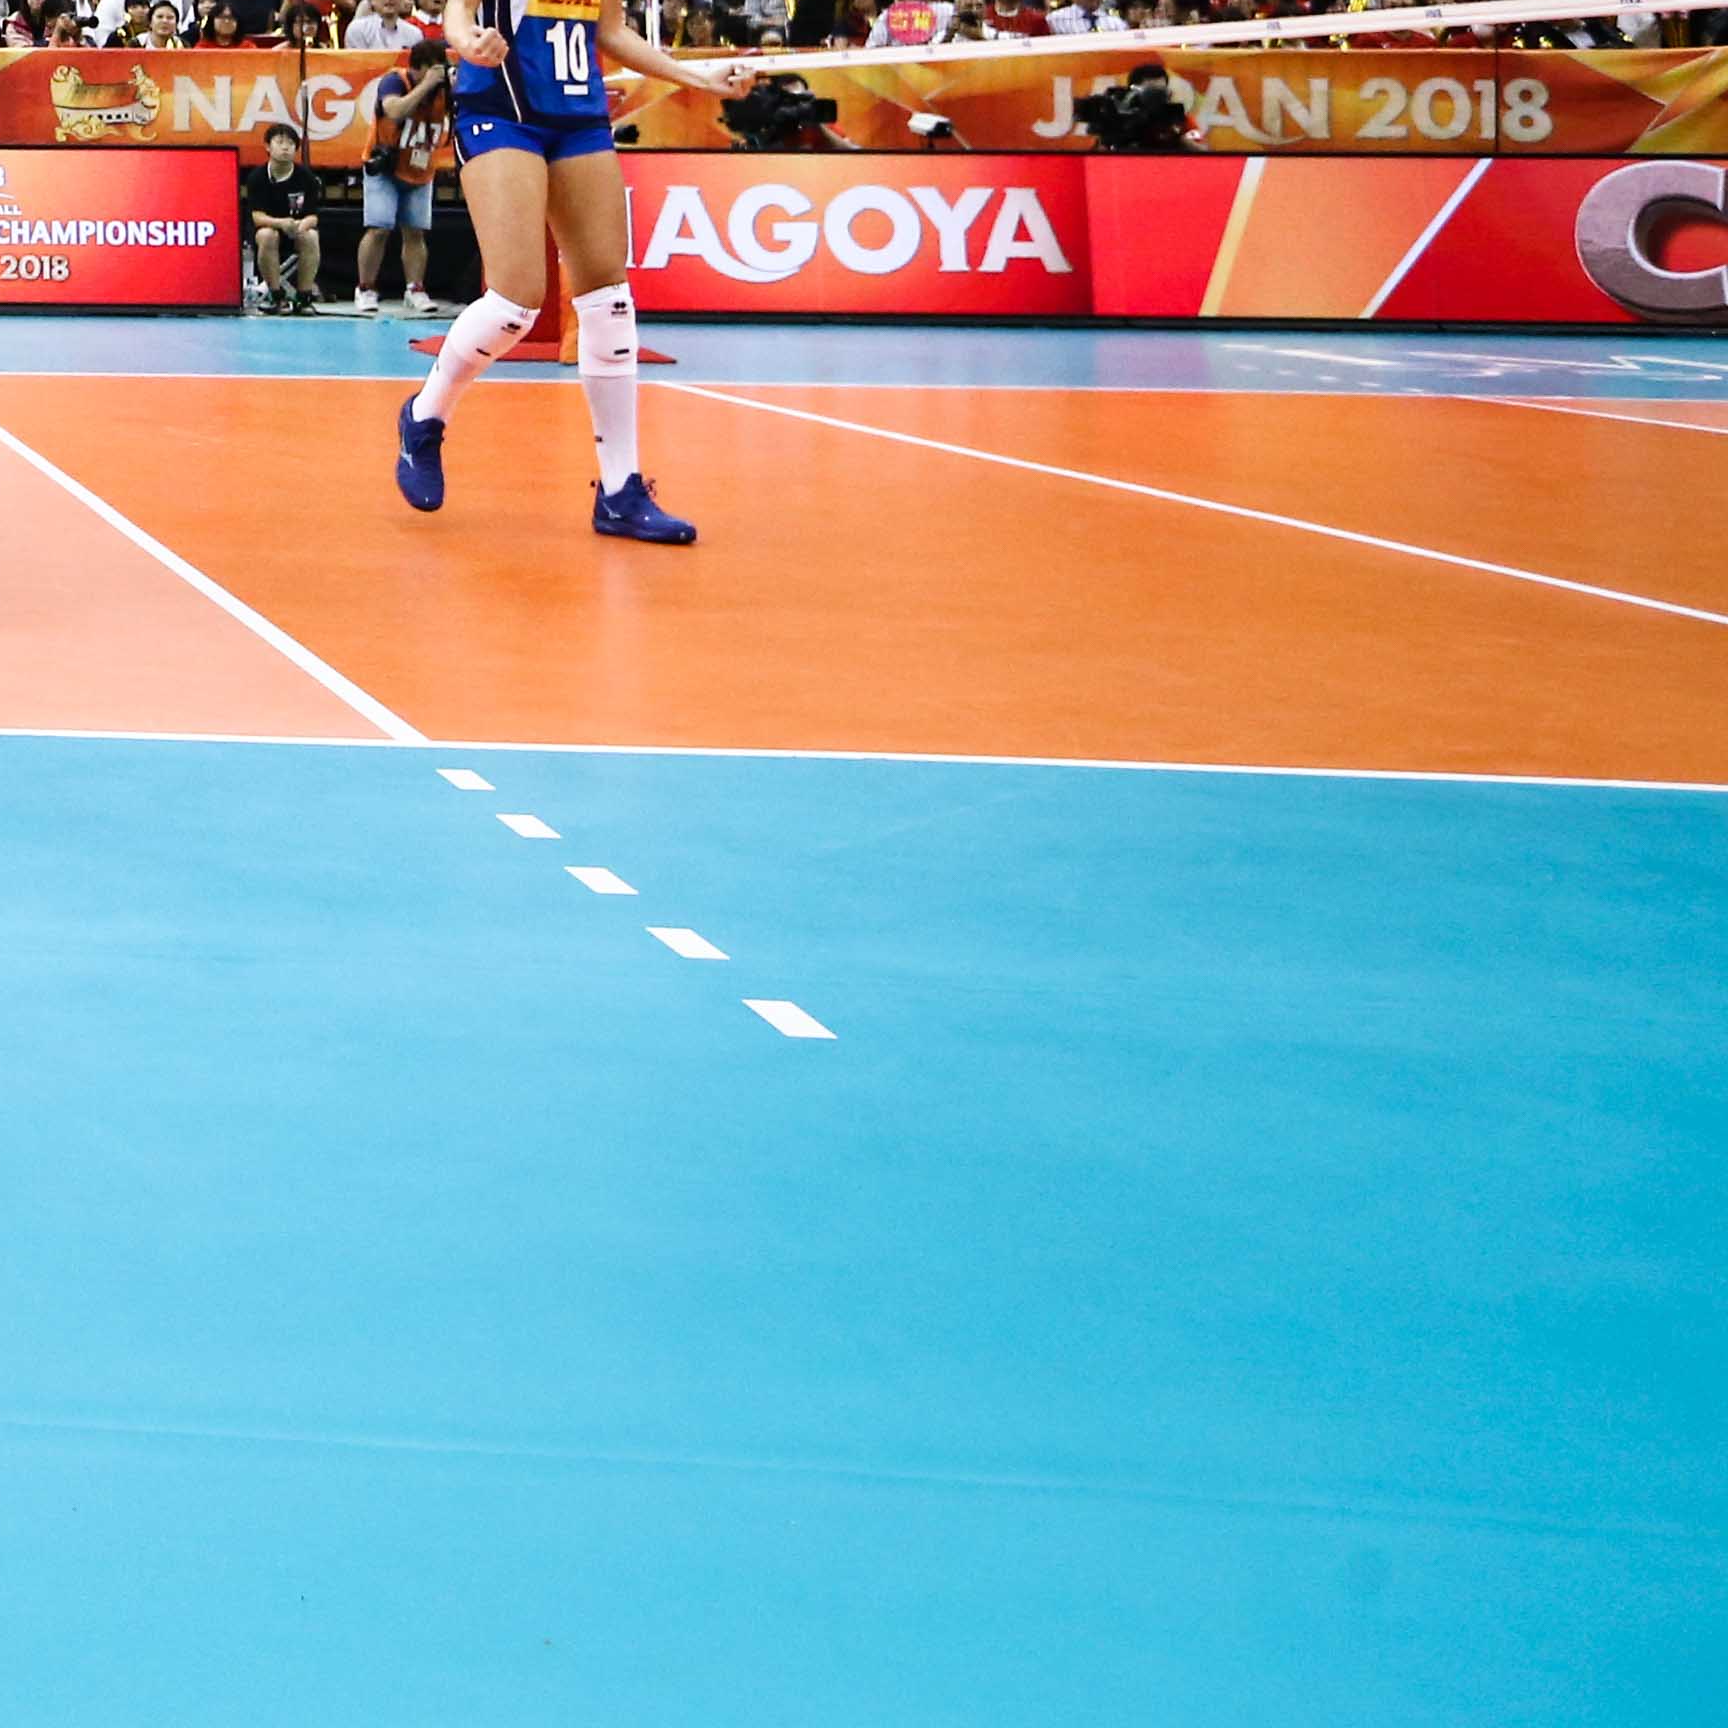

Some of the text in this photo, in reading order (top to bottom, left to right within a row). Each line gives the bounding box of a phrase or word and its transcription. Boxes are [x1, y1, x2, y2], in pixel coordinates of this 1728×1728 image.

[546, 20, 590, 83] 10
[1355, 75, 1554, 143] 2018
[0, 254, 71, 282] 2018
